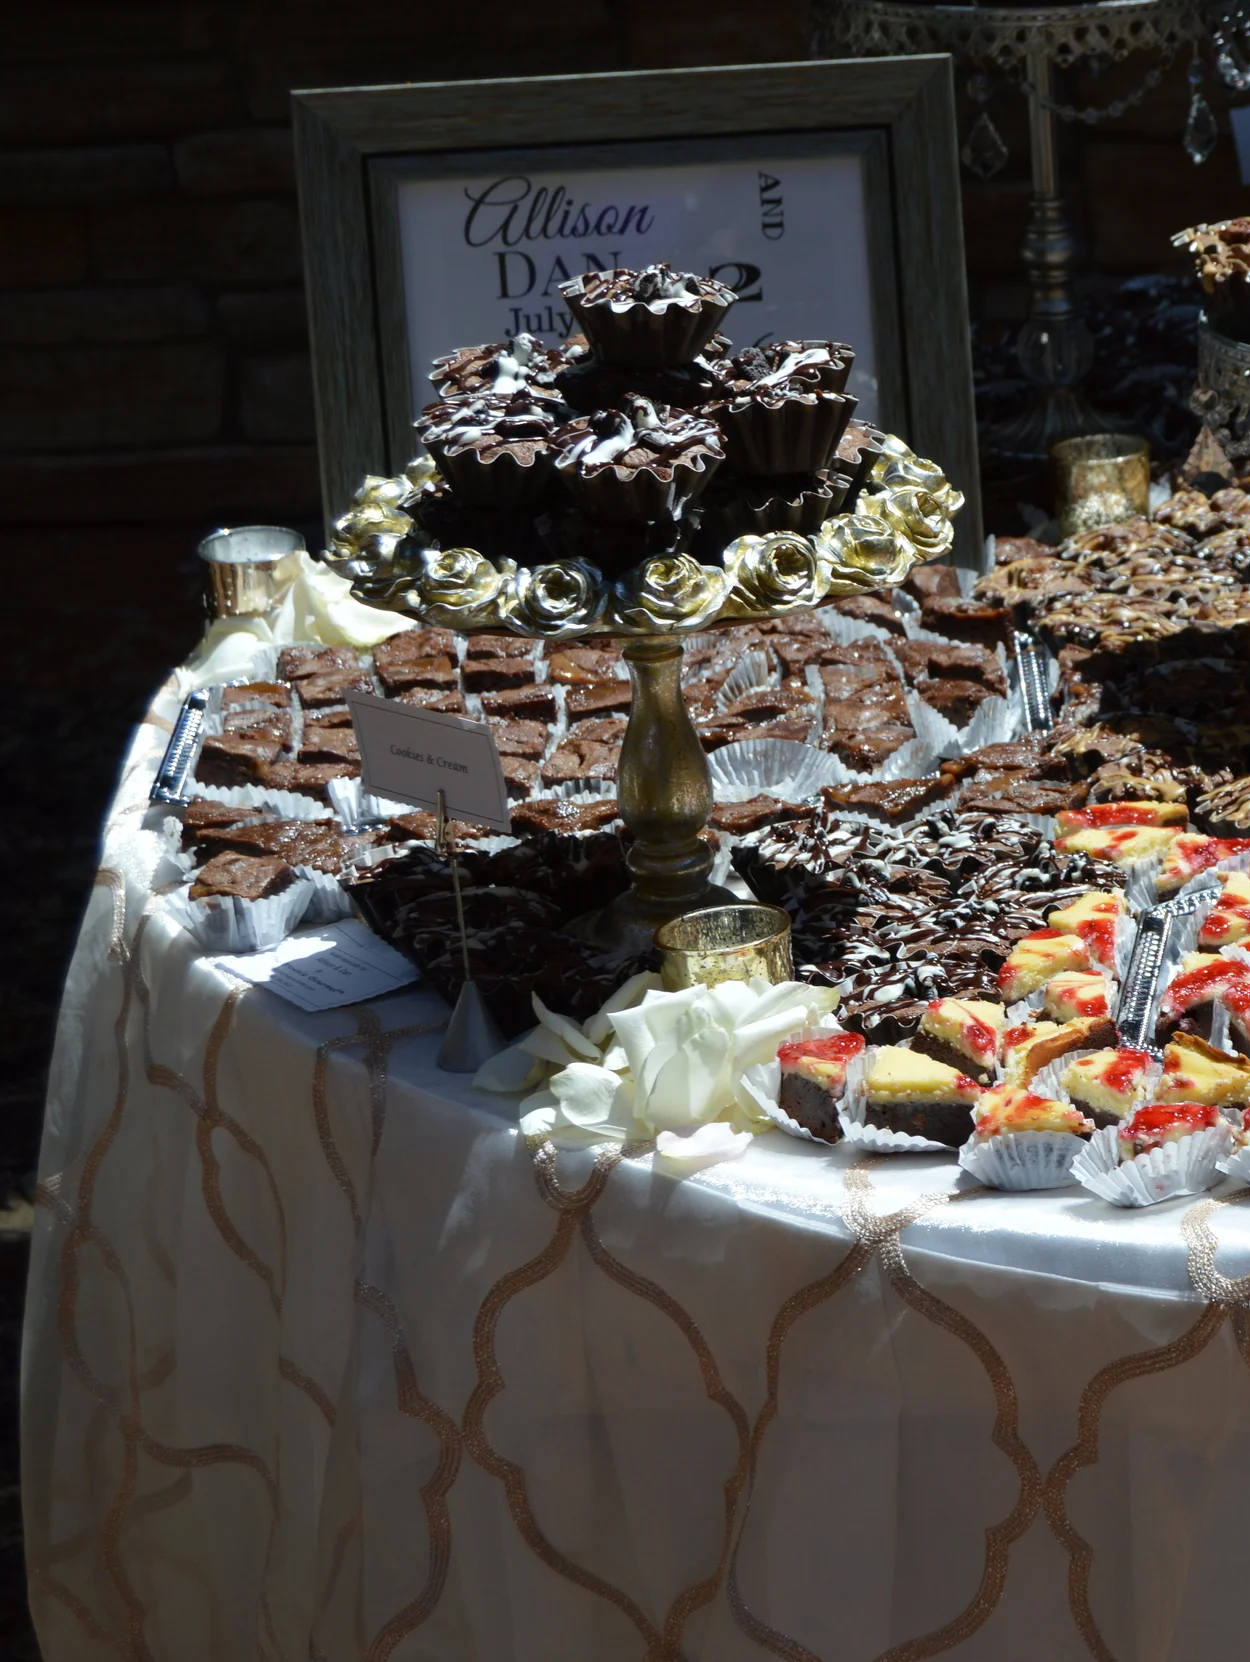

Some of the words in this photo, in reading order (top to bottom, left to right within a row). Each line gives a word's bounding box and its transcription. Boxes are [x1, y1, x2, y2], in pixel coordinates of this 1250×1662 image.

[463, 175, 656, 248] Allison
[757, 170, 784, 241] AND
[504, 305, 575, 339] July
[389, 744, 424, 762] Cookies
[426, 754, 435, 765] &
[436, 756, 469, 774] Cream
